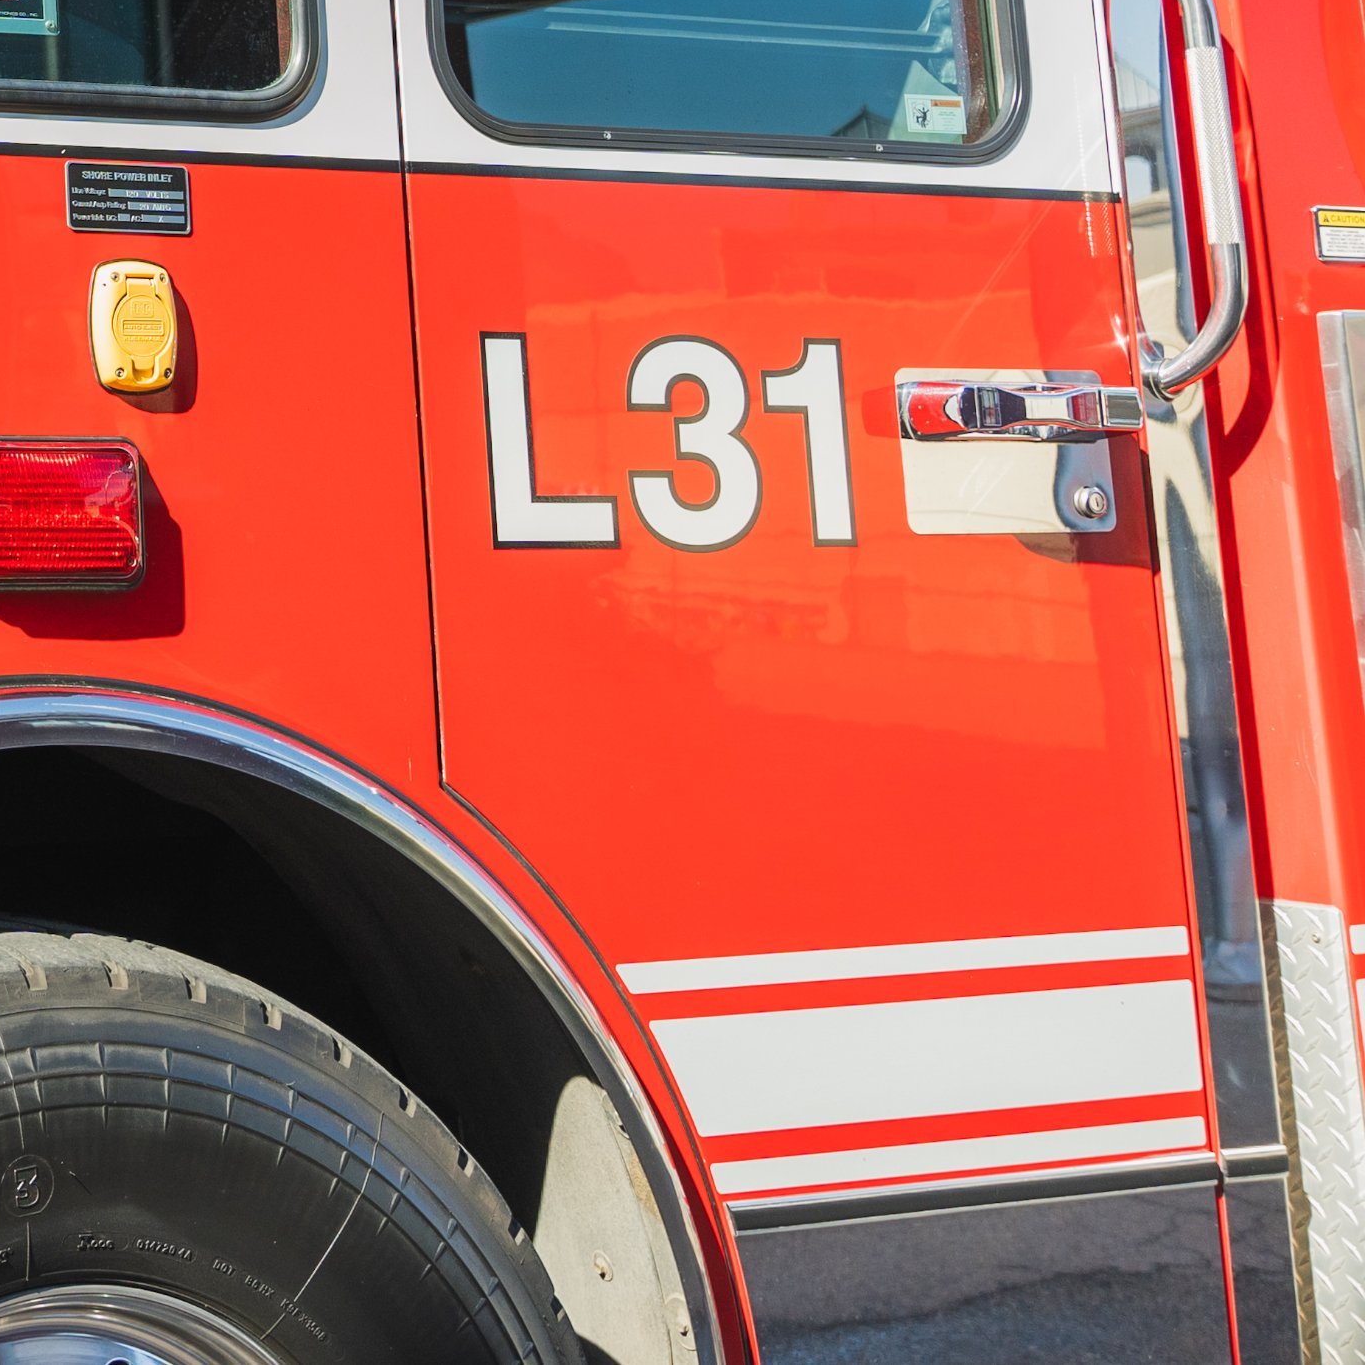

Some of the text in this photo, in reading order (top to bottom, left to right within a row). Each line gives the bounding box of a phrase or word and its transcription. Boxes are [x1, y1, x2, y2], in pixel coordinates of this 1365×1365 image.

[81, 170, 174, 183] SHORE POWER INLET
[479, 331, 859, 554] L31
